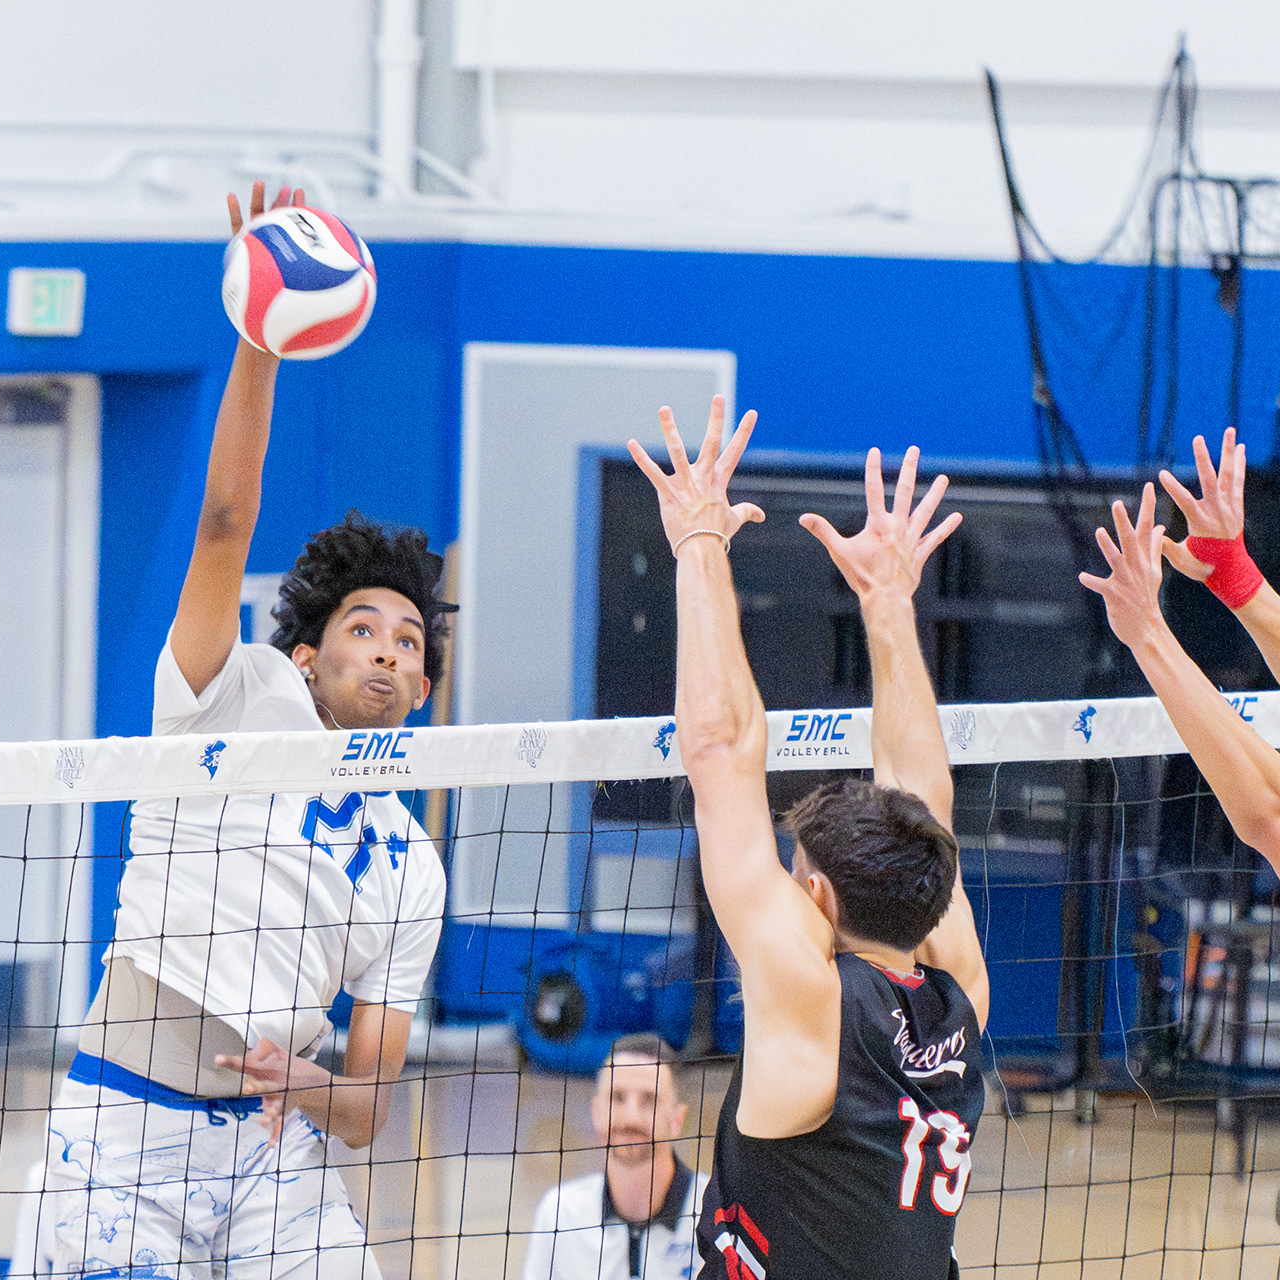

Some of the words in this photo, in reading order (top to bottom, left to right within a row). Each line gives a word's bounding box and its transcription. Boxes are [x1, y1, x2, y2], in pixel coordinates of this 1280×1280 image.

[785, 713, 853, 742] SMC
[341, 731, 414, 761] SMC
[776, 746, 850, 757] VOLLEYBALL
[330, 765, 412, 777] VOLLEYBALL
